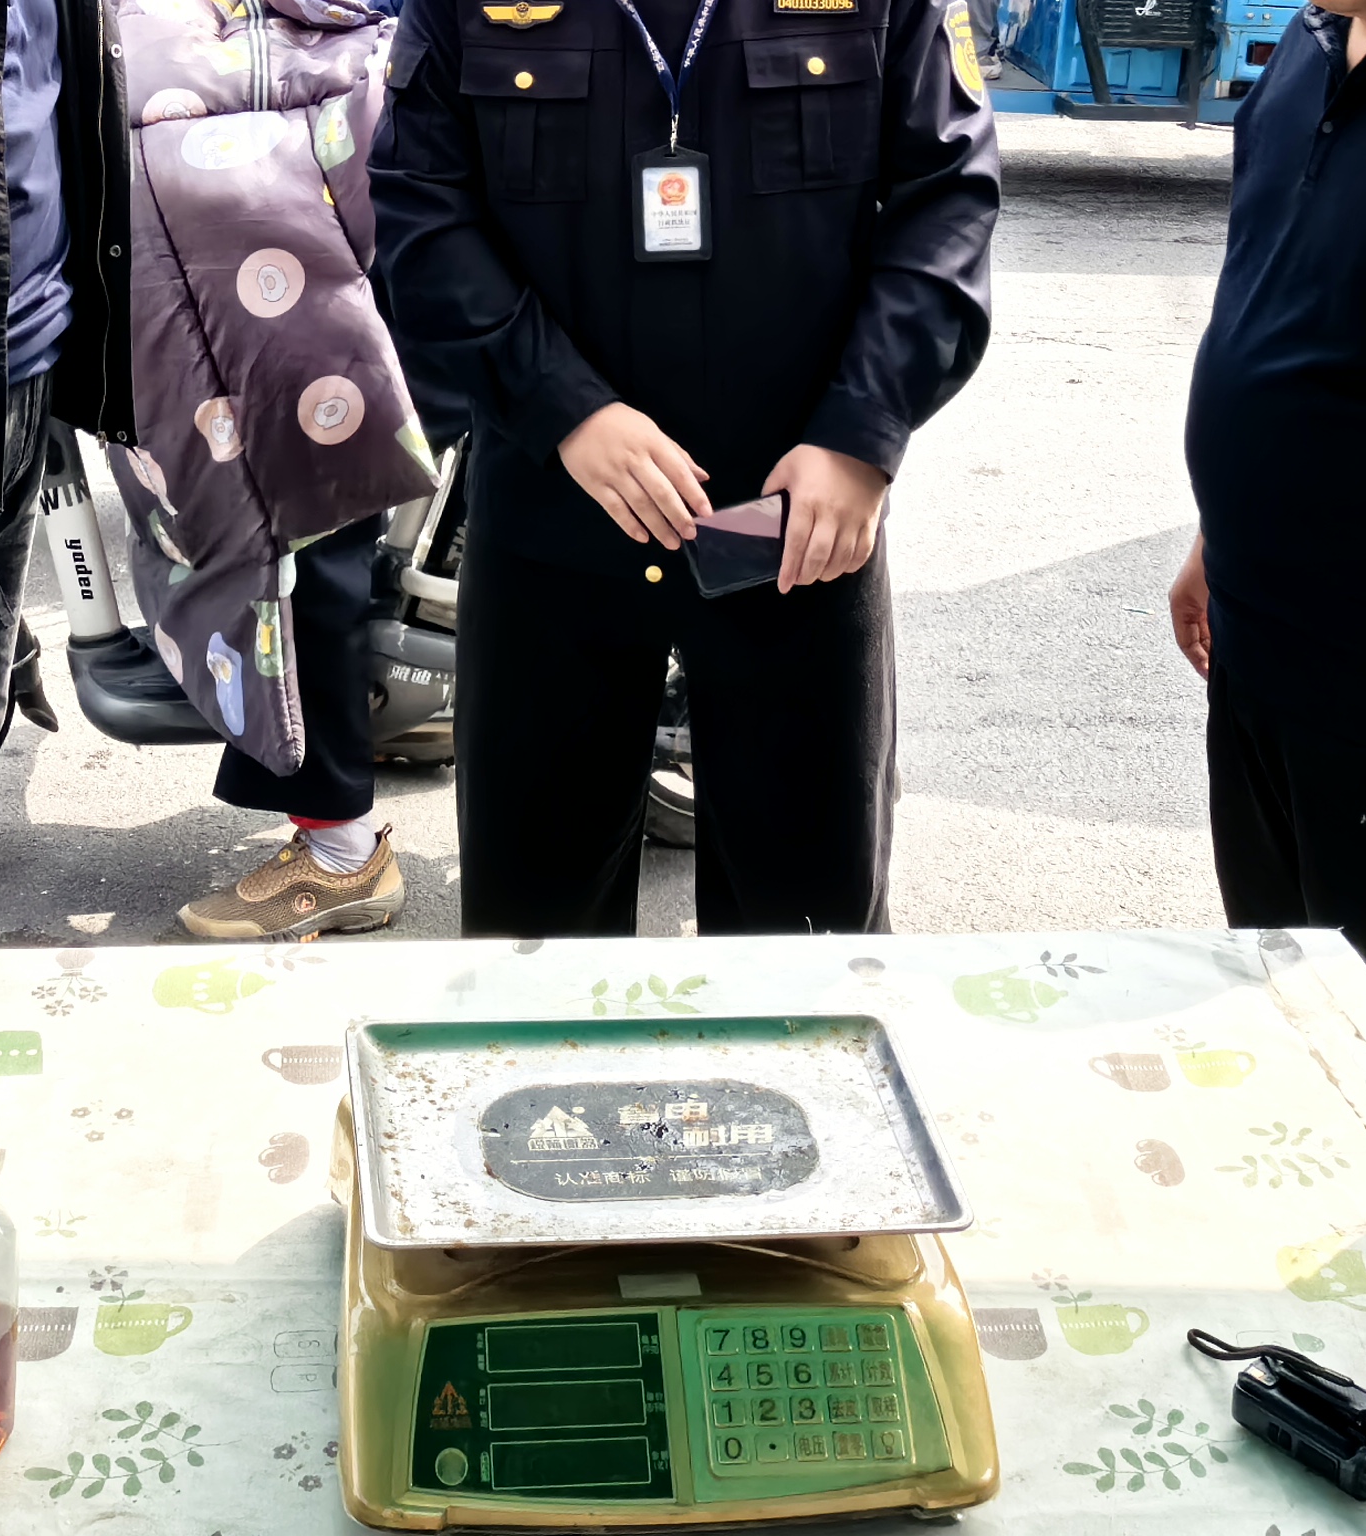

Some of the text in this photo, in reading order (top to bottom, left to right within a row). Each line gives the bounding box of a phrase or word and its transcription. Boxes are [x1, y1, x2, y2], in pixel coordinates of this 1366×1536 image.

[64, 538, 94, 600] yadea
[713, 1329, 730, 1351] 7
[751, 1328, 769, 1350] 8
[789, 1327, 806, 1348] 9
[717, 1363, 734, 1386] 4
[756, 1363, 773, 1385] 5
[794, 1362, 812, 1384] 6
[722, 1400, 732, 1422] 1
[758, 1398, 777, 1421] 2
[798, 1397, 816, 1420] 3
[724, 1437, 742, 1460] 0
